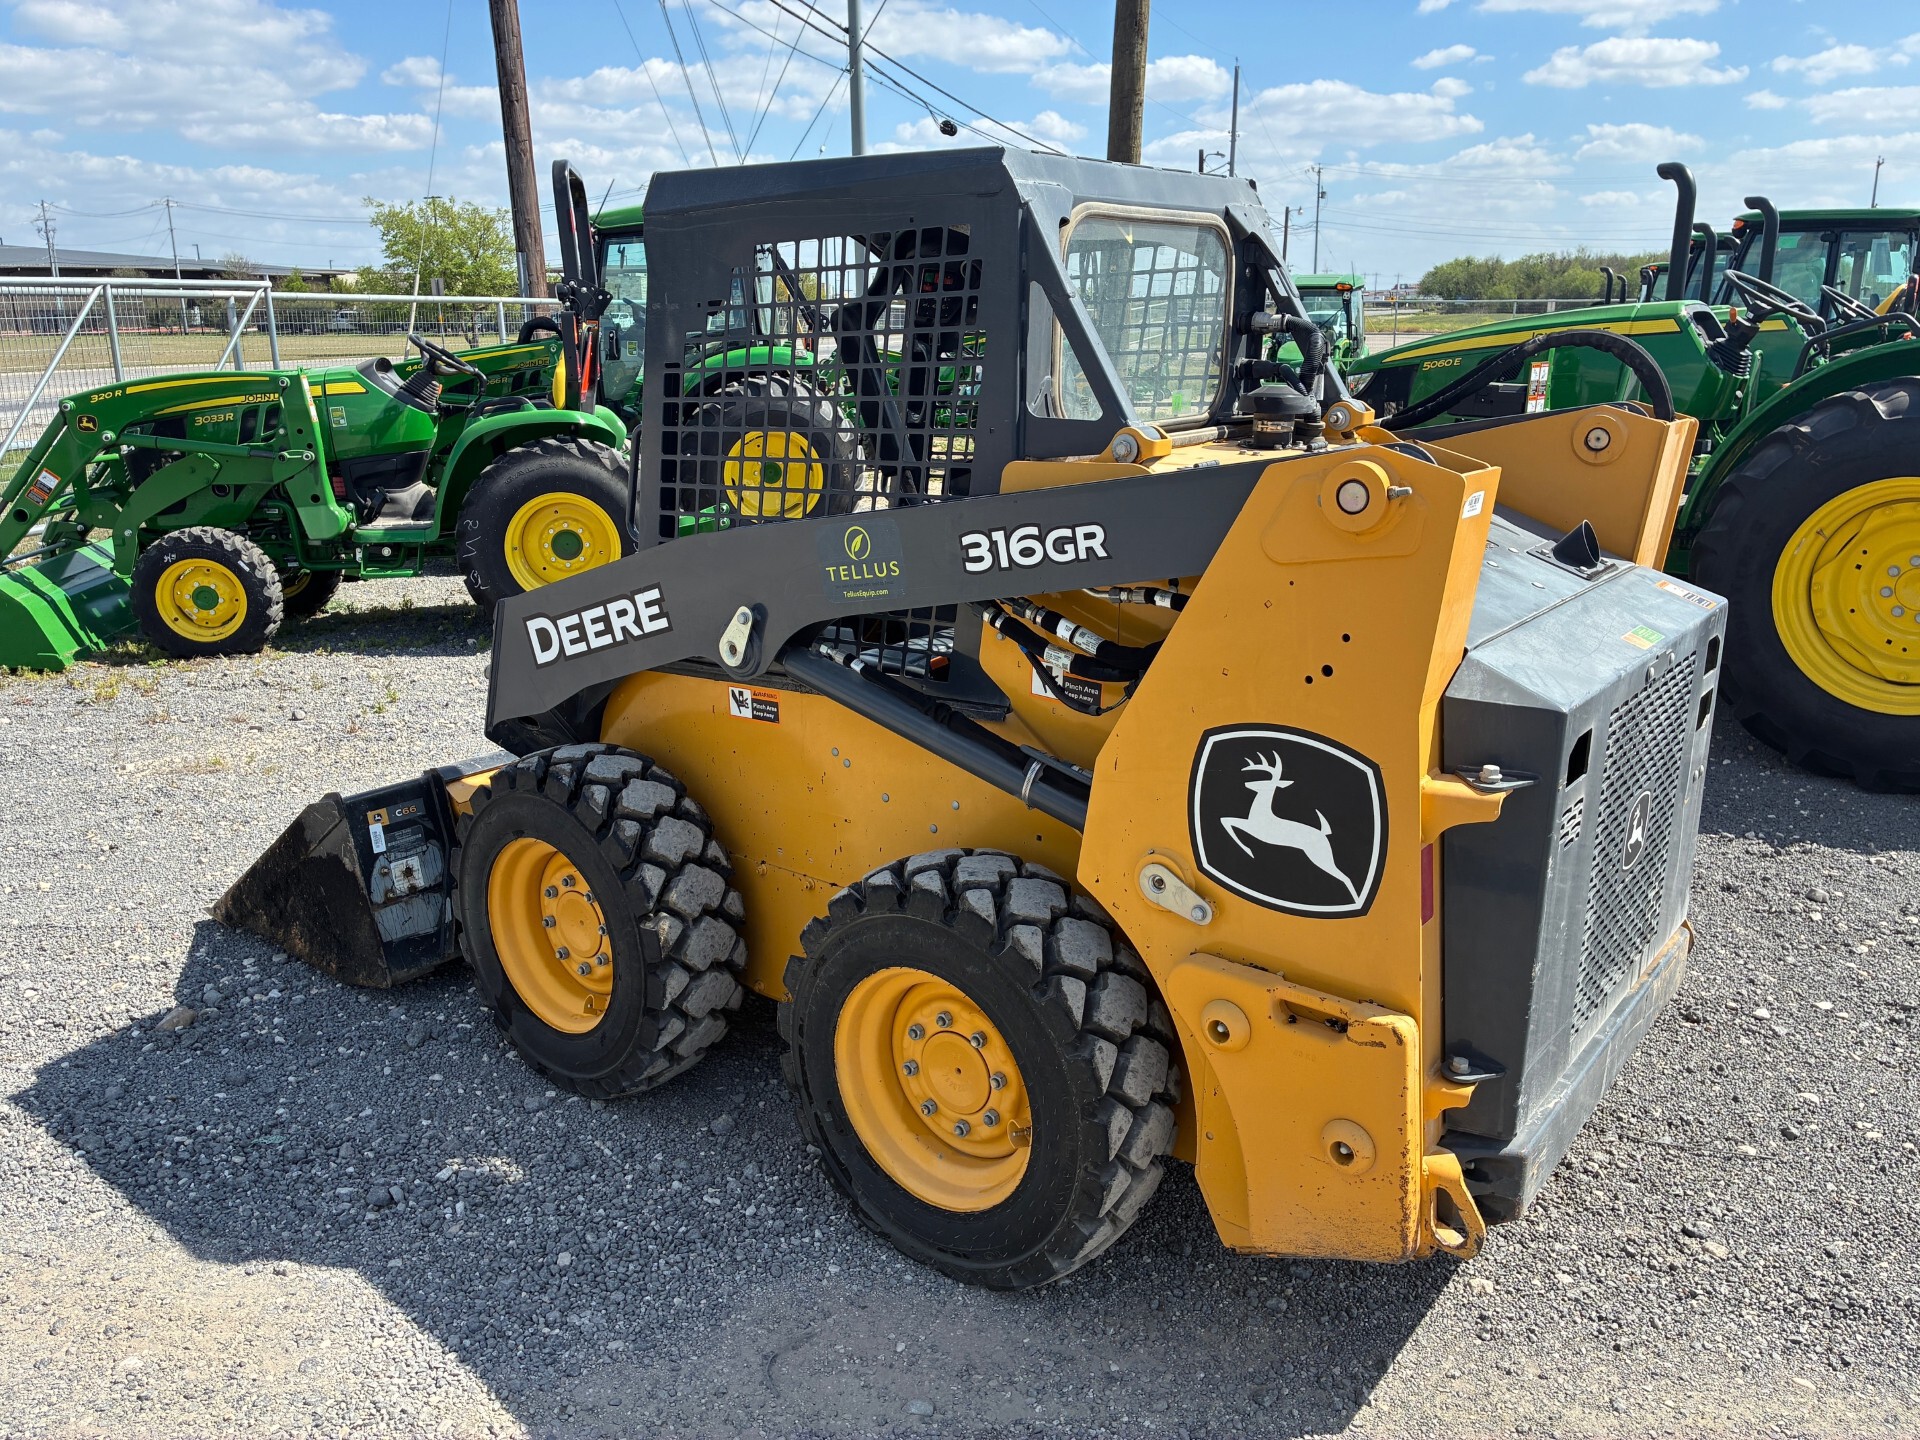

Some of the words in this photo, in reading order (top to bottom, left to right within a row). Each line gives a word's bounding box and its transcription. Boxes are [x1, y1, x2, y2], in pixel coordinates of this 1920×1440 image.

[1422, 358, 1452, 371] 5060
[1453, 357, 1462, 367] E
[90, 391, 113, 403] 320
[114, 389, 123, 398] R
[241, 393, 271, 403] JOHN
[194, 413, 224, 426] 3033
[225, 412, 235, 421] R
[961, 524, 1109, 573] 316GR
[825, 560, 900, 582] TELLUS
[843, 588, 889, 598] TellusEquip.com
[526, 588, 669, 665] DEERE
[1065, 681, 1083, 692] Pinch
[1083, 685, 1099, 696] Area
[1079, 694, 1093, 703] Away
[753, 702, 766, 710] Pinch
[395, 805, 417, 817] C66
